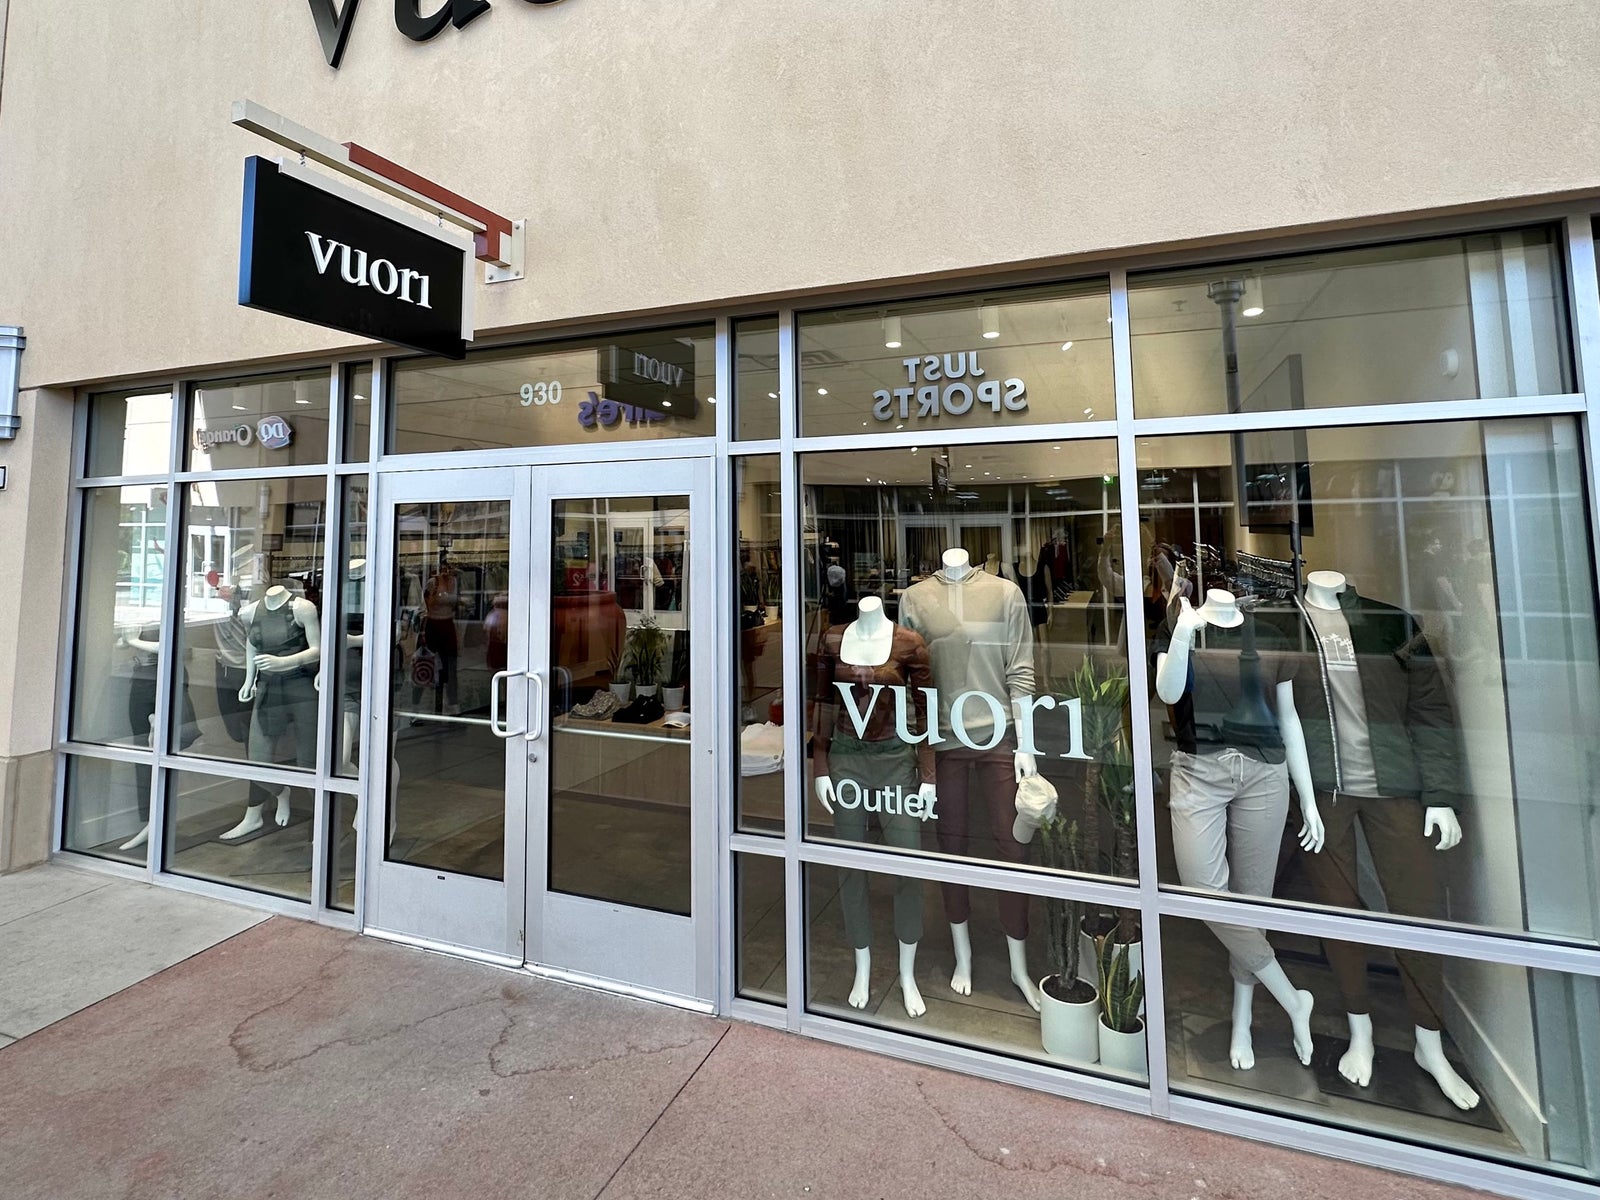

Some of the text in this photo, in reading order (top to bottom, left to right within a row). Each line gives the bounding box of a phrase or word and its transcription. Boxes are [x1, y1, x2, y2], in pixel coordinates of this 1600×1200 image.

[304, 231, 432, 309] vuori
[520, 380, 562, 407] 930
[832, 681, 1094, 760] vuori
[836, 778, 939, 820] Outlet
